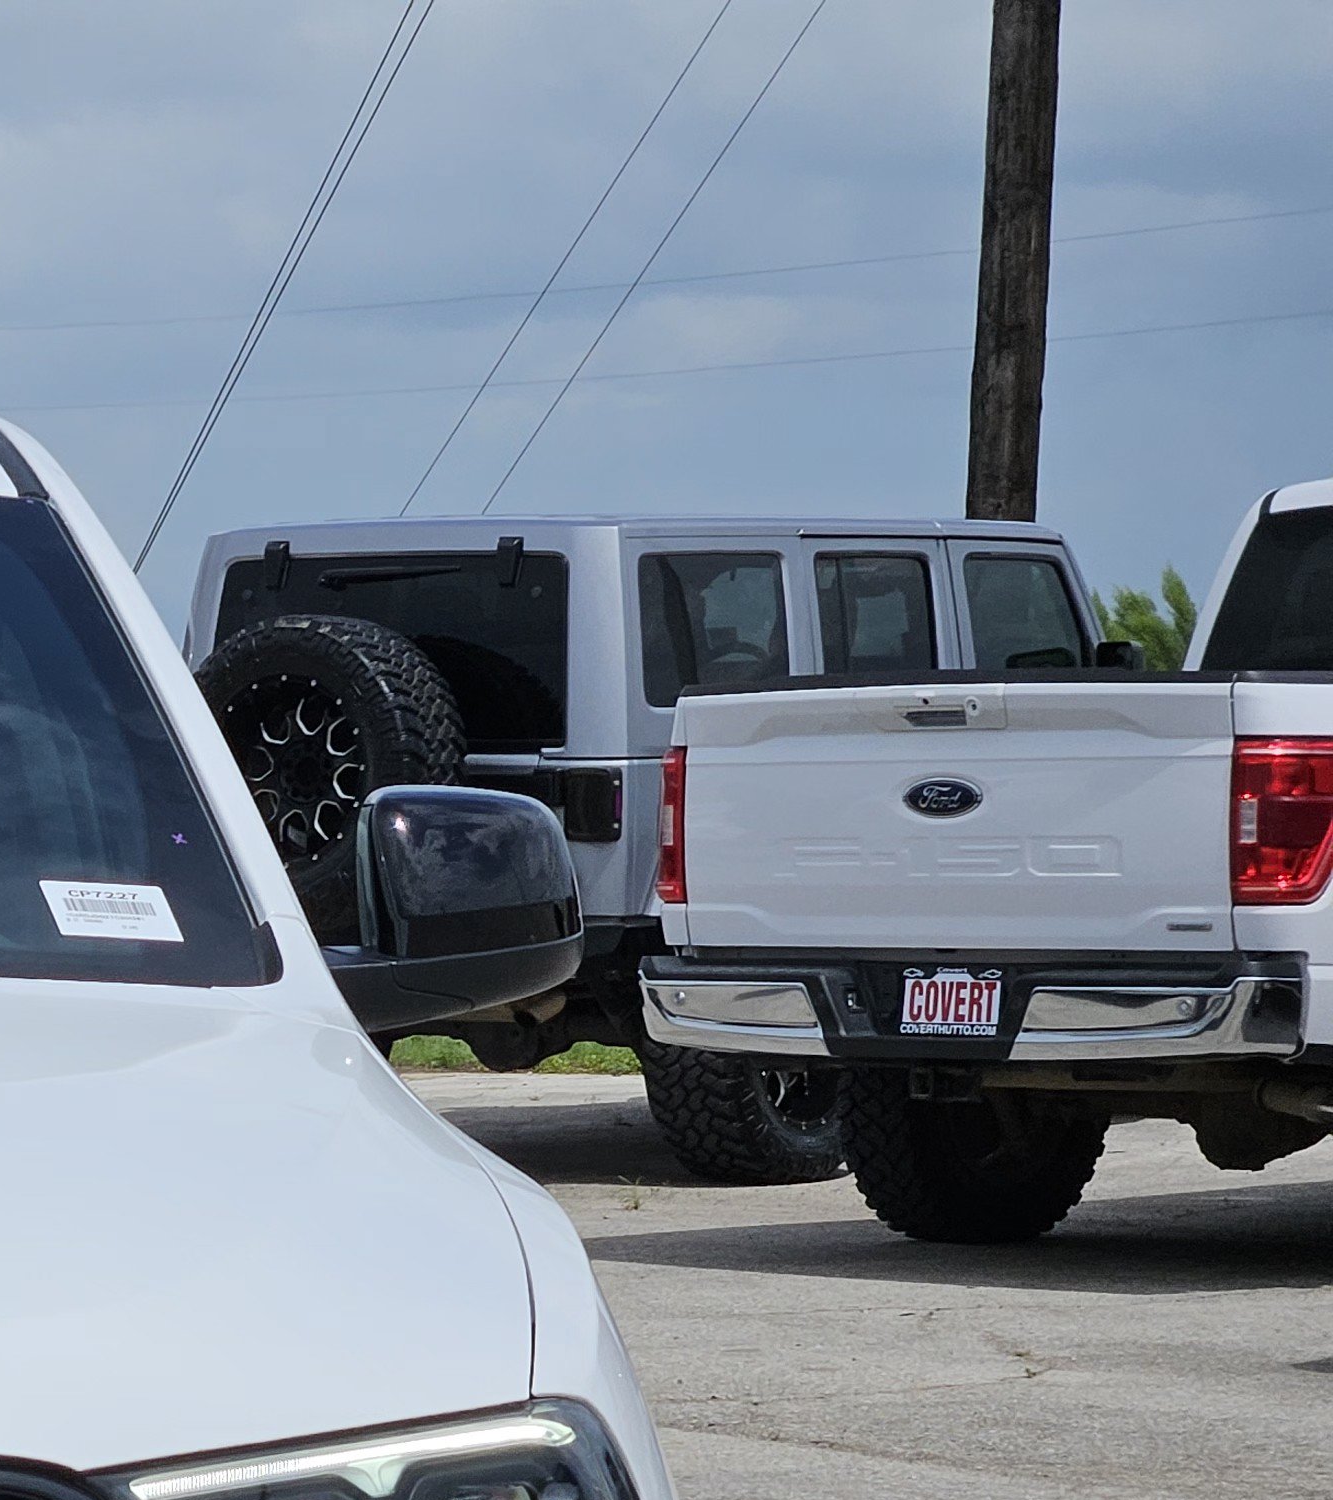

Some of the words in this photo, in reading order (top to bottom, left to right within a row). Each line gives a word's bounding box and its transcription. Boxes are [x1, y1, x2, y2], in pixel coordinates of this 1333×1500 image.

[919, 786, 962, 808] Ford
[908, 980, 997, 1023] COVERT
[899, 1023, 997, 1036] COVERTHUTTO.COM
